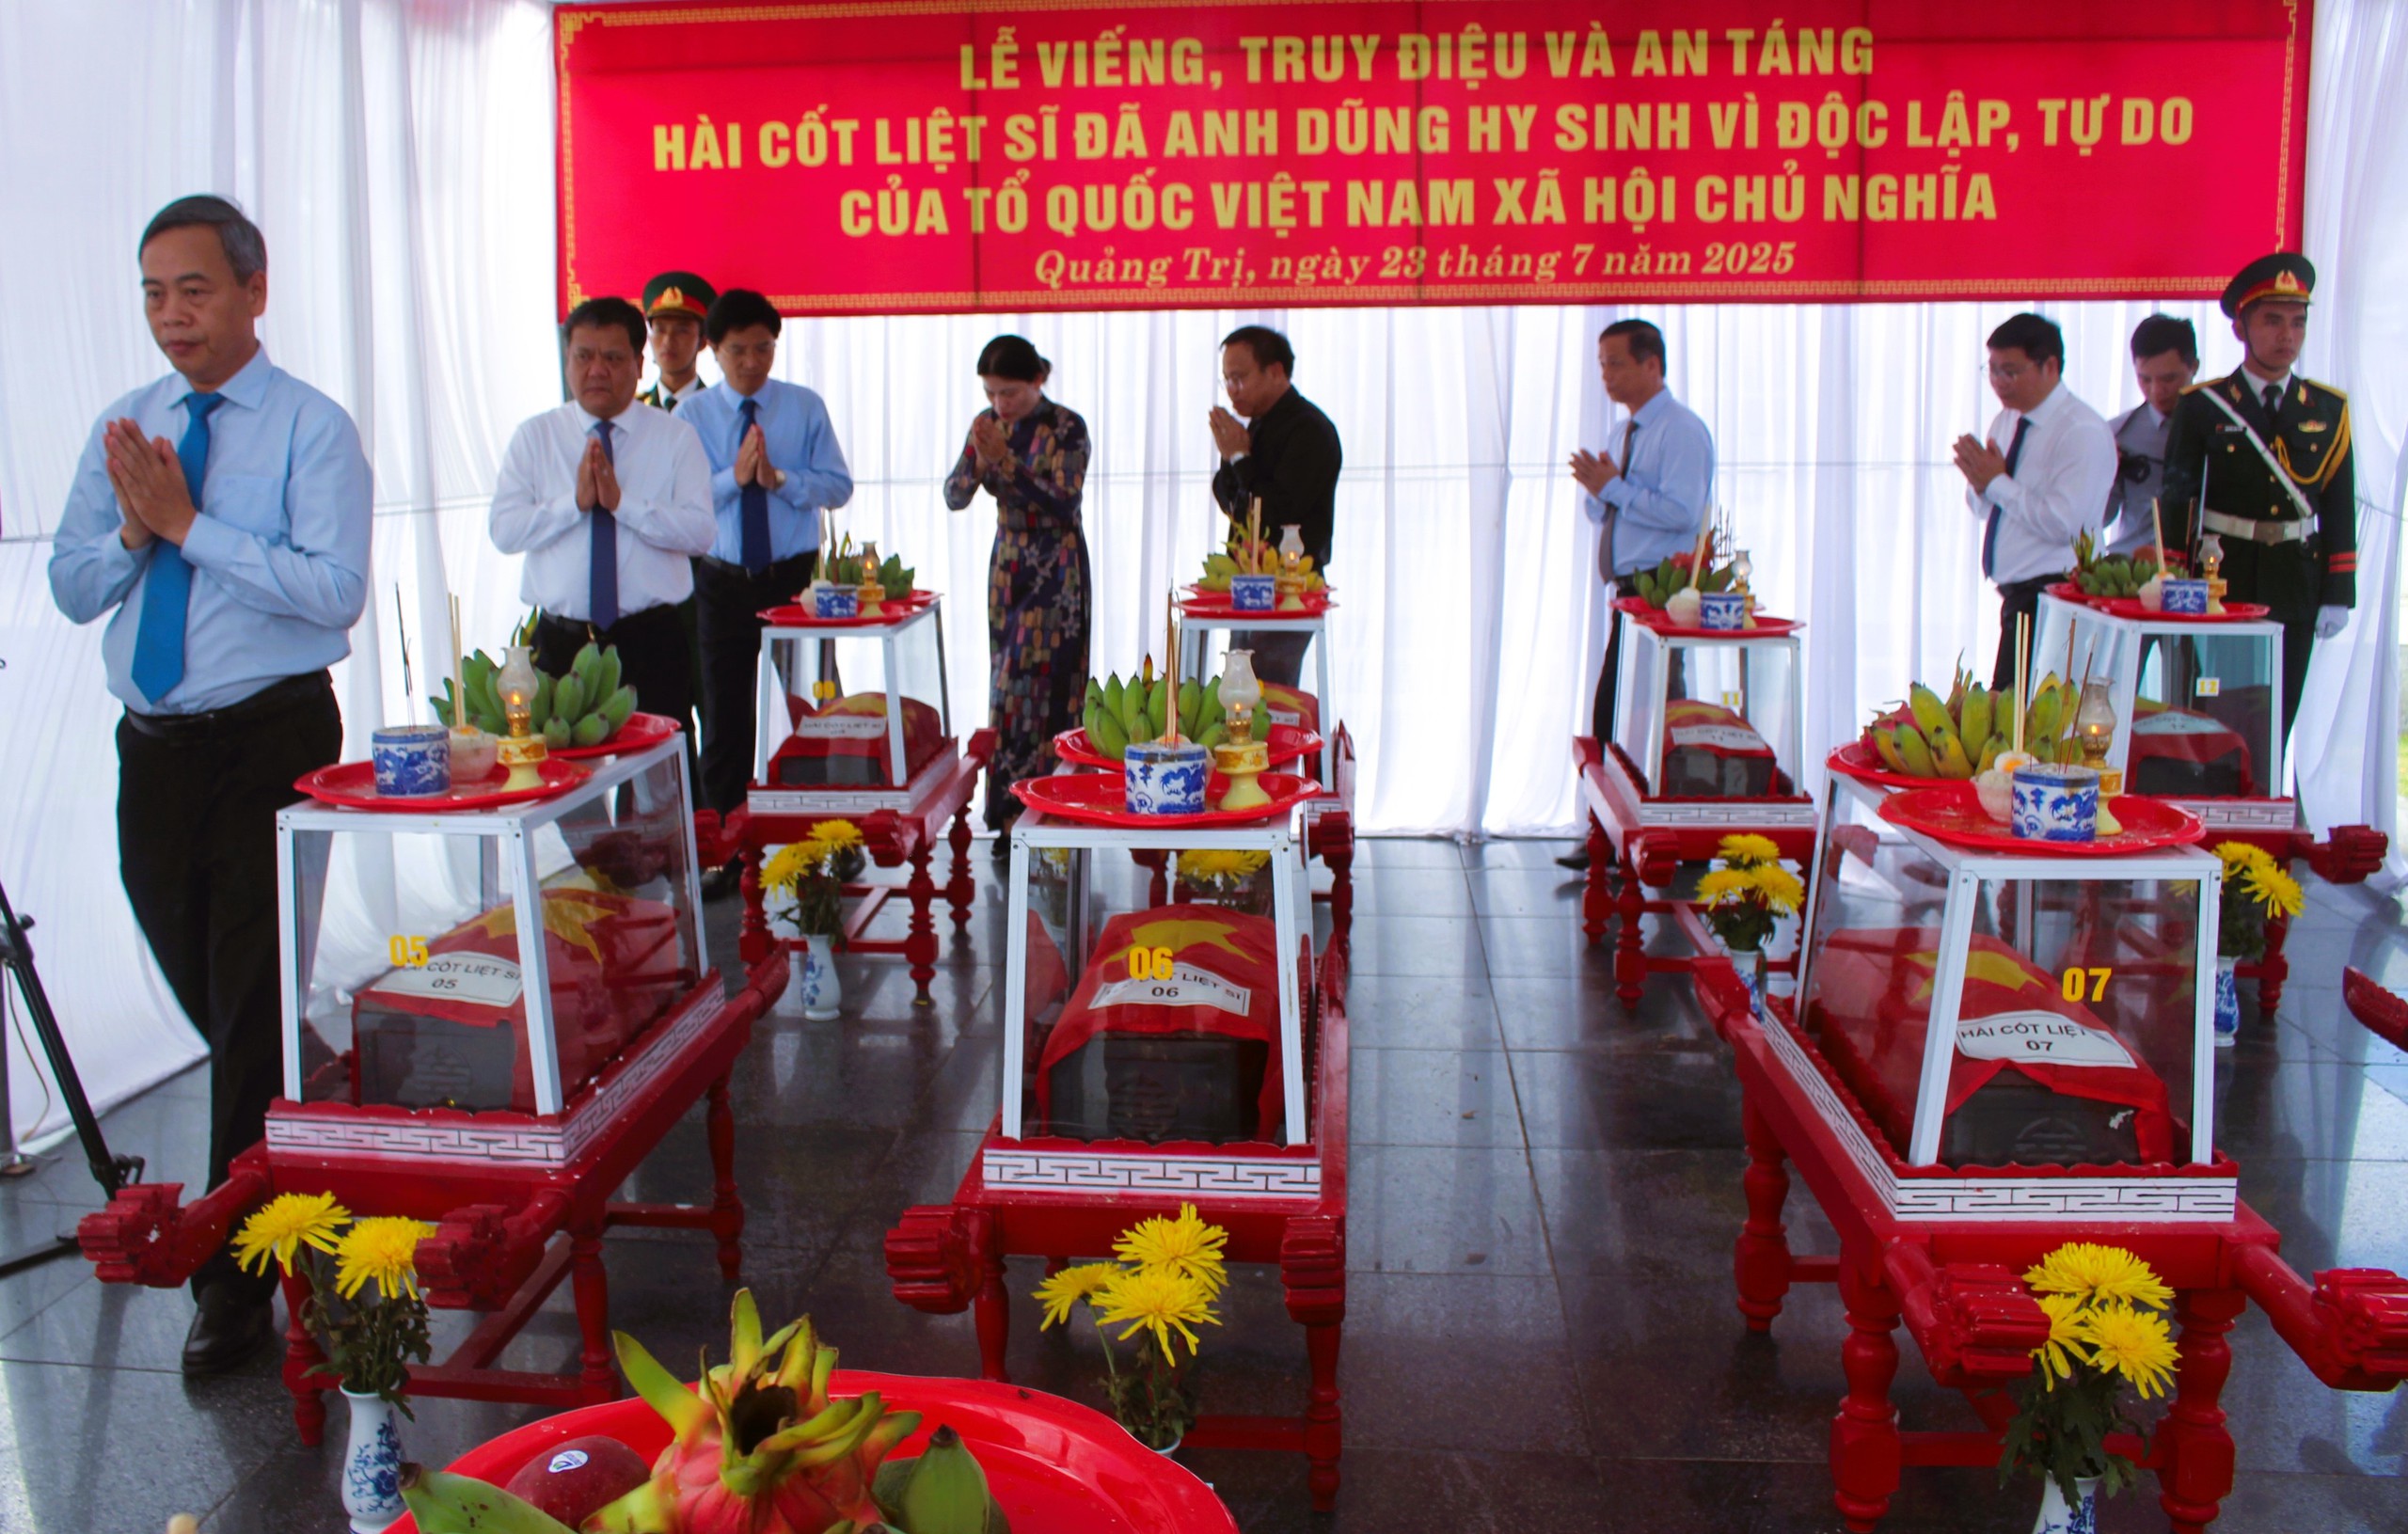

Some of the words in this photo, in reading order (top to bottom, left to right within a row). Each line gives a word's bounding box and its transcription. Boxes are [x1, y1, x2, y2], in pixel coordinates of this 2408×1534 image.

[960, 25, 1020, 89] LỄ
[1037, 24, 1223, 89] VIẾNG,
[1240, 35, 1381, 83] TRUY
[1397, 23, 1527, 89] ĐIỆU
[1545, 21, 1615, 77] VÀ
[1632, 29, 1708, 76] AN
[1726, 19, 1874, 75] TÁNG
[653, 115, 742, 171] HÀI
[759, 104, 860, 167] CỐT
[875, 108, 988, 173] LIỆT
[1003, 104, 1058, 161] SĨ
[1073, 103, 1149, 160] ĐÃ
[1164, 108, 1278, 158] ANH
[1297, 99, 1450, 154] DŨNG
[1468, 104, 1538, 152] HY
[1555, 102, 1690, 150] SINH
[1707, 92, 1760, 150] VÌ
[1776, 91, 1889, 159] ĐỘC
[1907, 90, 2019, 158] LẬP,
[2037, 93, 2111, 156] TỰ
[2121, 97, 2194, 146] DO
[840, 174, 950, 237] CỦA
[963, 167, 1028, 234] TỔ
[1046, 167, 1195, 237] QUỐC
[1210, 172, 1331, 238] VIỆT
[1347, 179, 1476, 228] NAM
[1492, 167, 1566, 225] XÃ
[1583, 167, 1676, 233] HỘI
[1695, 160, 1805, 223] CHỦ
[1823, 165, 1997, 222] NGHĨA
[1035, 245, 1173, 290] Quảng
[1182, 247, 1256, 289] Trị,
[1270, 247, 1370, 285] ngày
[1378, 245, 1427, 278] 23
[1437, 244, 1561, 282] tháng
[1572, 243, 1595, 276] 7
[1603, 243, 1691, 275] năm
[1701, 241, 1798, 275] 2025
[389, 934, 429, 968] 05
[1129, 946, 1174, 981] 06
[432, 978, 458, 989] 05
[1151, 987, 1180, 999] 06
[2062, 967, 2112, 1003] 07
[2026, 1039, 2054, 1052] 07
